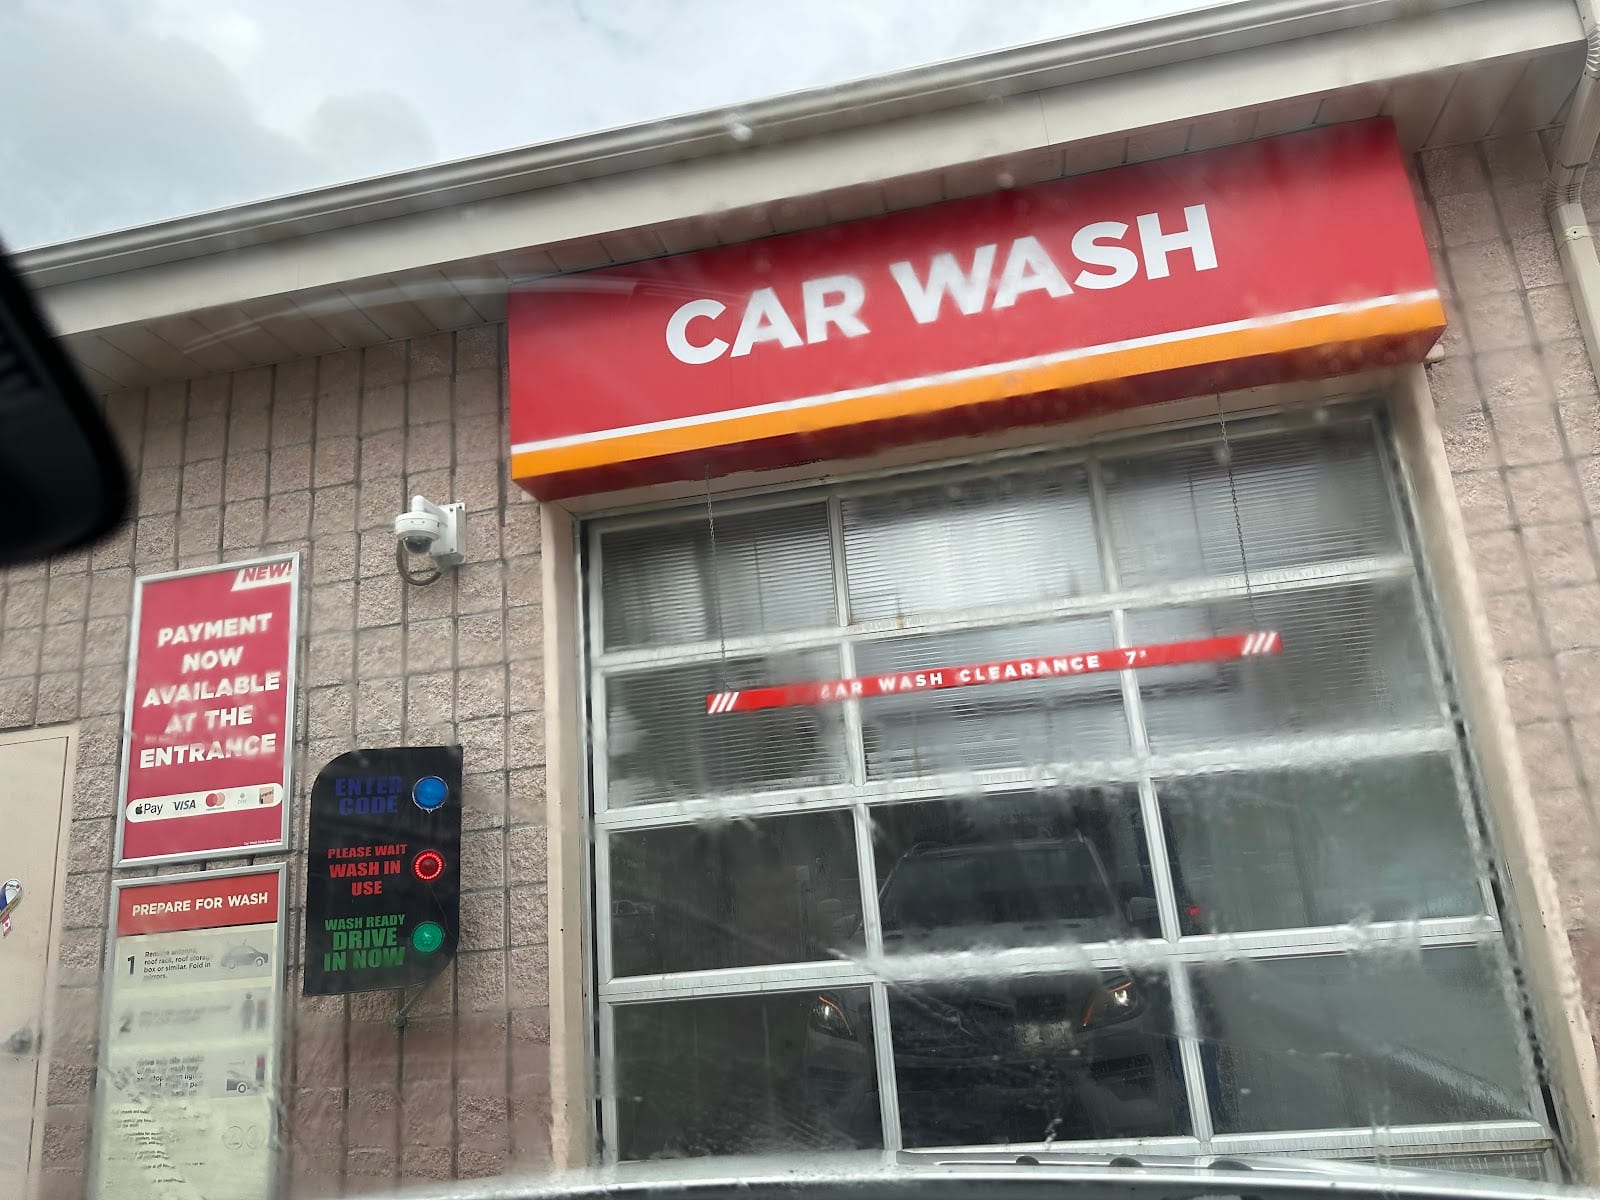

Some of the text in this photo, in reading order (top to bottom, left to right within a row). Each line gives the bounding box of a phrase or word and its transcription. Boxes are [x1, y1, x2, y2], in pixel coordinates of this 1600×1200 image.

[665, 203, 1219, 365] CAR WASH
[242, 561, 293, 583] NEW!
[157, 613, 273, 648] PAYMENT
[181, 646, 244, 674] NOW
[821, 680, 864, 700] CAR
[879, 672, 944, 692] WASH
[959, 654, 1100, 684] CLEARANCE
[142, 671, 281, 708] AVAILABLE
[164, 704, 254, 735] AT THE
[139, 733, 277, 769] ENTRANCE
[335, 776, 404, 797] ENTER
[173, 799, 197, 812] VISA
[339, 796, 398, 816] CODE
[327, 843, 408, 860] PLEASE WAIT
[329, 859, 402, 879] WASH IN
[351, 880, 383, 897] USE
[132, 892, 268, 917] PREPARE FOR WASH
[324, 913, 406, 932] WASH READY
[332, 928, 398, 952] DRIVE
[127, 955, 136, 975] 1
[323, 946, 406, 972] IN NOW
